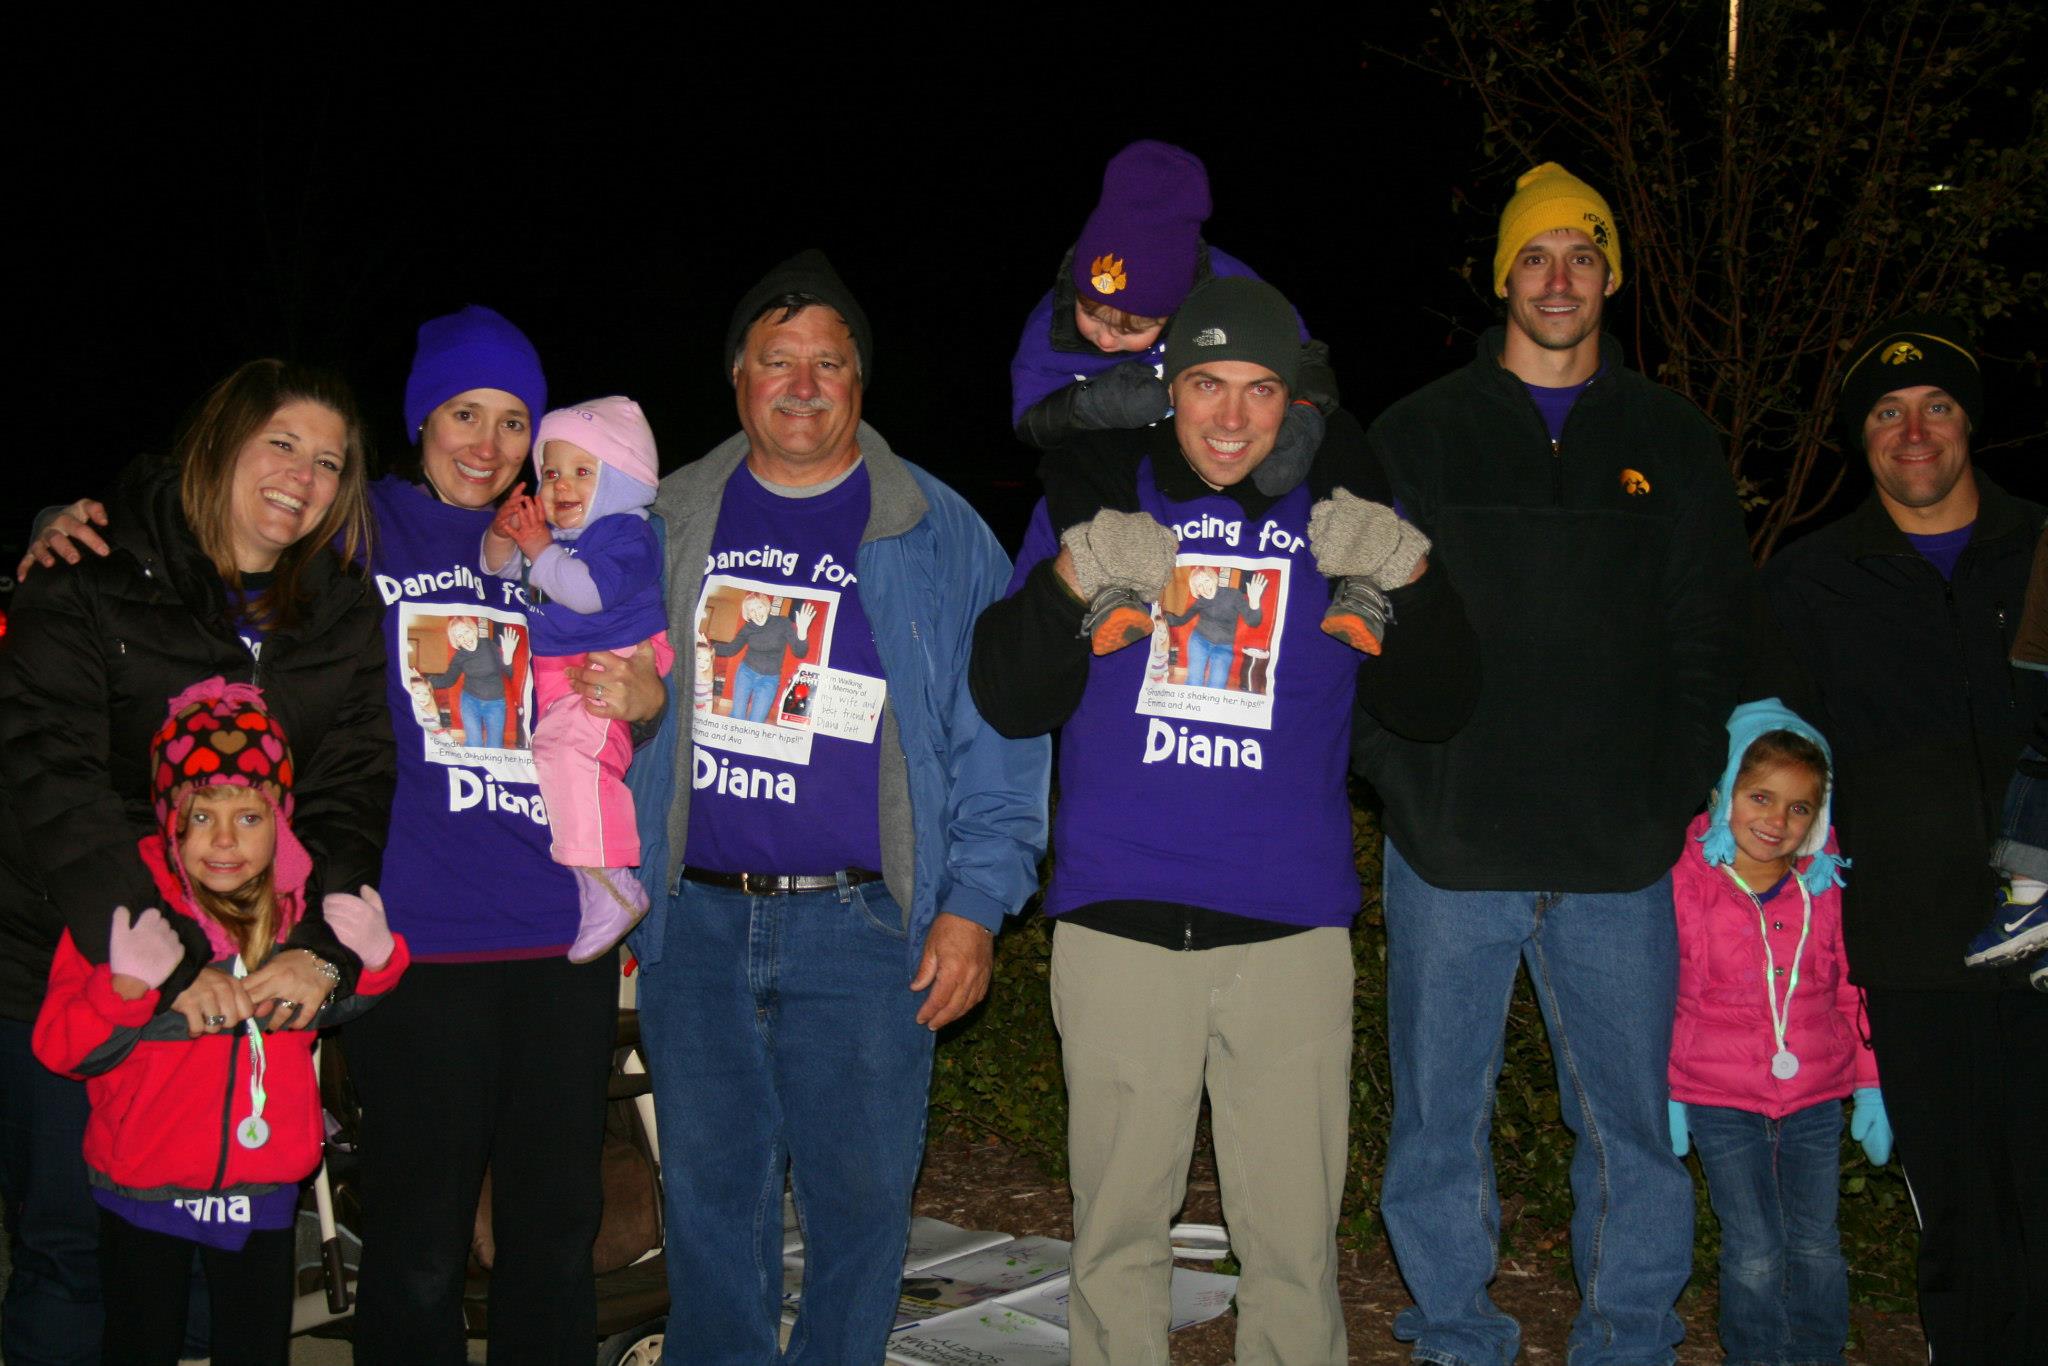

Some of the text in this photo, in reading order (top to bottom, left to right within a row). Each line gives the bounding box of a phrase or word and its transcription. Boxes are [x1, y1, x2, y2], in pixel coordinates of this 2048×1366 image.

[1172, 513, 1305, 554] ncing for
[811, 553, 858, 588] for
[375, 564, 486, 607] Dancing
[832, 685, 859, 697] Memory
[839, 696, 858, 708] wife
[1187, 691, 1220, 704] shaking
[1223, 696, 1238, 704] her
[1168, 701, 1183, 710] and
[1186, 703, 1201, 711] Ava
[711, 732, 726, 742] and
[728, 736, 743, 745] Ava
[721, 723, 729, 731] is
[730, 724, 760, 739] shaking
[762, 730, 777, 739] her
[1142, 717, 1263, 770] Diana
[504, 754, 518, 763] her
[692, 744, 796, 804] Diana
[447, 766, 549, 826] Diana
[173, 1195, 251, 1223] ana
